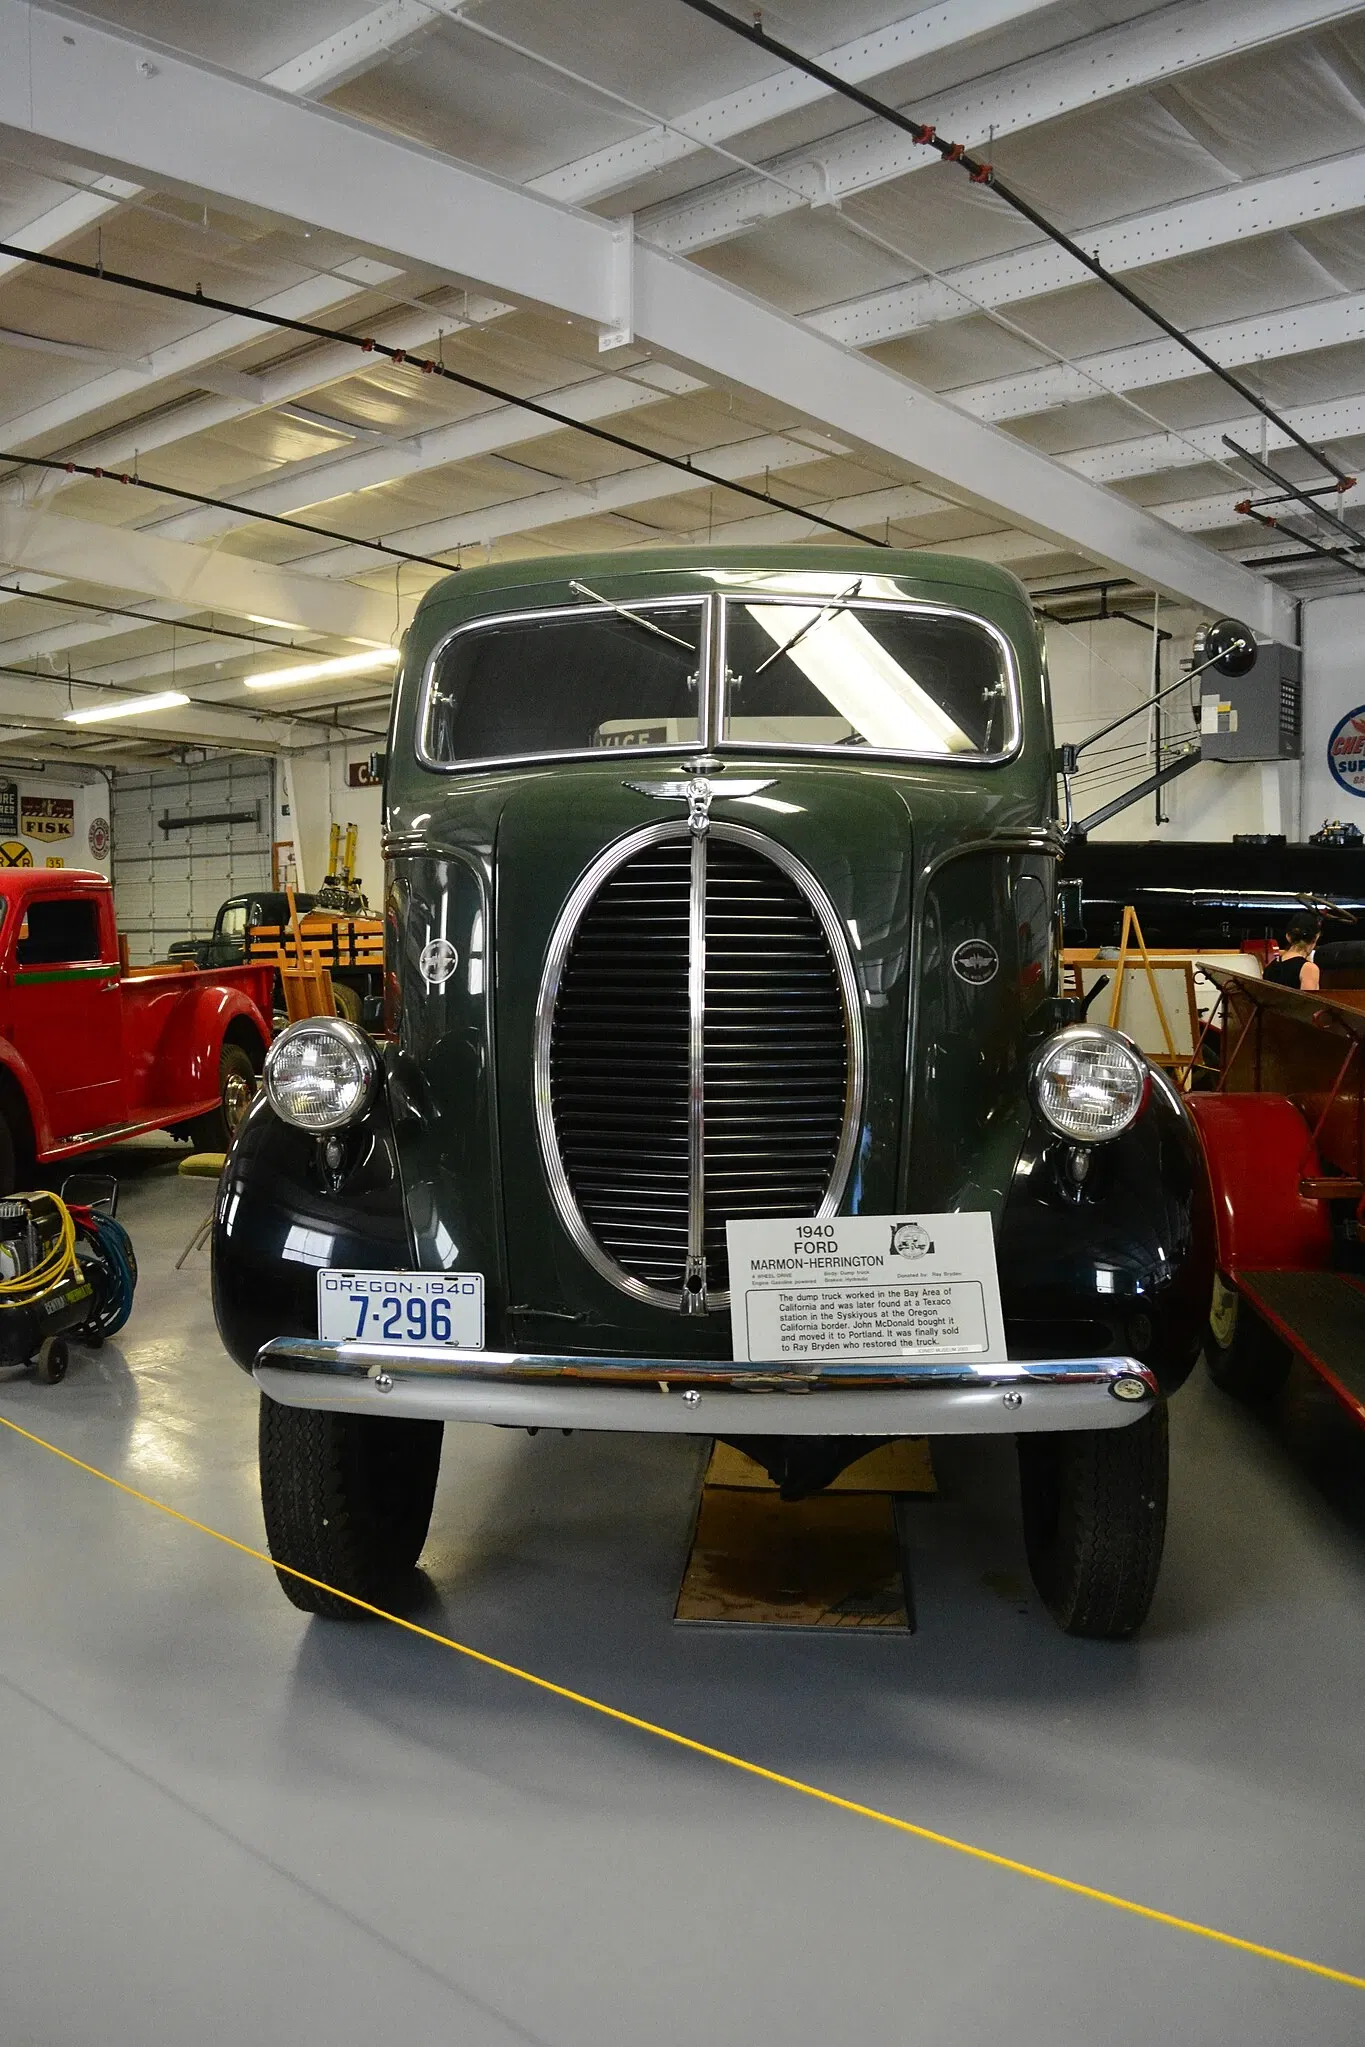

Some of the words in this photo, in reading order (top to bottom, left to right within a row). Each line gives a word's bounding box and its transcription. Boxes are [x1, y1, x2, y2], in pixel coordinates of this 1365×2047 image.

[1331, 736, 1365, 756] CHE
[26, 821, 71, 834] FISK
[22, 858, 31, 867] R
[48, 859, 61, 868] 35
[796, 1225, 835, 1238] 1940
[794, 1241, 838, 1254] FORD
[751, 1256, 884, 1270] MARMON-HERRINGTON
[779, 1294, 793, 1302] The
[797, 1294, 819, 1303] dump
[822, 1292, 841, 1300] truck
[845, 1291, 875, 1299] worked
[878, 1290, 885, 1298] in
[888, 1290, 901, 1298] the
[904, 1289, 919, 1298] Bay
[922, 1288, 941, 1296] Area
[779, 1303, 817, 1312] California
[820, 1302, 835, 1310] and
[857, 1301, 875, 1309] later
[878, 1300, 901, 1308] found
[904, 1299, 912, 1307] at
[923, 1298, 952, 1306] Texaco
[350, 1295, 451, 1341] 7-296
[780, 1313, 808, 1322] station
[811, 1312, 818, 1320] in
[821, 1311, 834, 1320] the
[837, 1310, 878, 1321] Syskiyous
[881, 1310, 889, 1318] at
[892, 1309, 905, 1317] the
[908, 1308, 938, 1318] Oregon
[780, 1323, 818, 1332] California
[821, 1322, 851, 1330] border.
[853, 1320, 872, 1329] John
[875, 1319, 915, 1328] McDonald
[918, 1318, 946, 1328] bought
[948, 1317, 955, 1325] it
[781, 1333, 796, 1342] and
[799, 1332, 826, 1341] moved
[828, 1331, 834, 1340] it
[837, 1331, 846, 1340] to
[849, 1330, 885, 1339] Portland.
[896, 1329, 912, 1337] was
[915, 1327, 939, 1336] finally
[942, 1326, 960, 1335] sold
[781, 1344, 790, 1352] to
[793, 1343, 809, 1353] Ray
[811, 1342, 841, 1352] Bryden
[843, 1341, 860, 1349] who
[862, 1339, 897, 1348] restored
[900, 1338, 913, 1347] the
[916, 1338, 940, 1346] truck.
